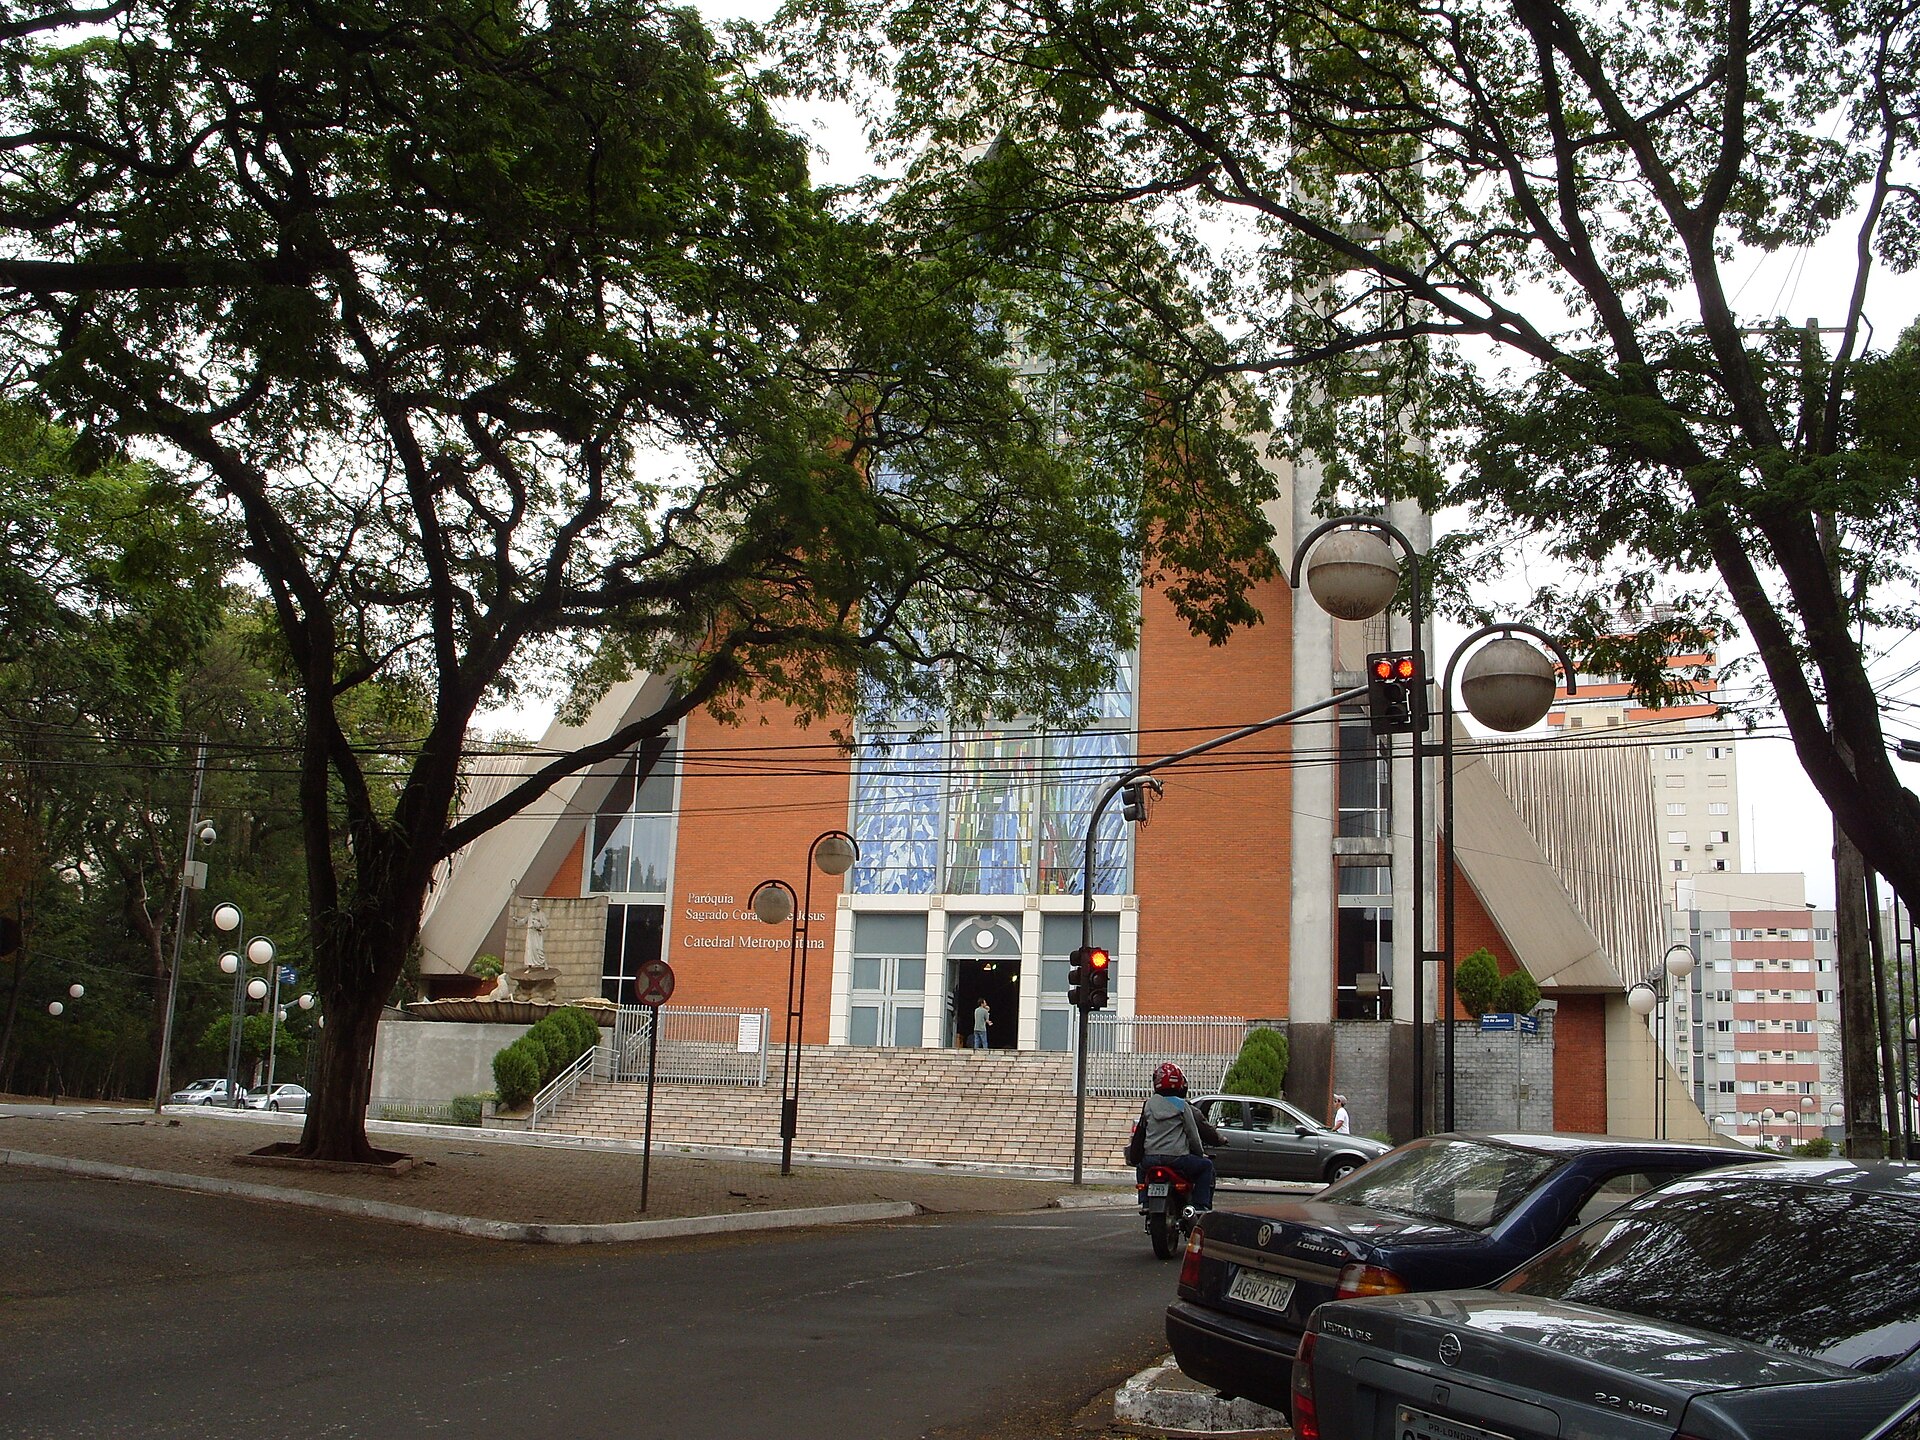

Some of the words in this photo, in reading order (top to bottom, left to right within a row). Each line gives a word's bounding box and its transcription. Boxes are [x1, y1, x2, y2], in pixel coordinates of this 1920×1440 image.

[687, 892, 734, 905] Paróquia
[685, 909, 729, 922] Sagrado
[732, 909, 763, 922] Cora
[684, 935, 734, 948] Catedral
[738, 935, 825, 951] Metropoitna
